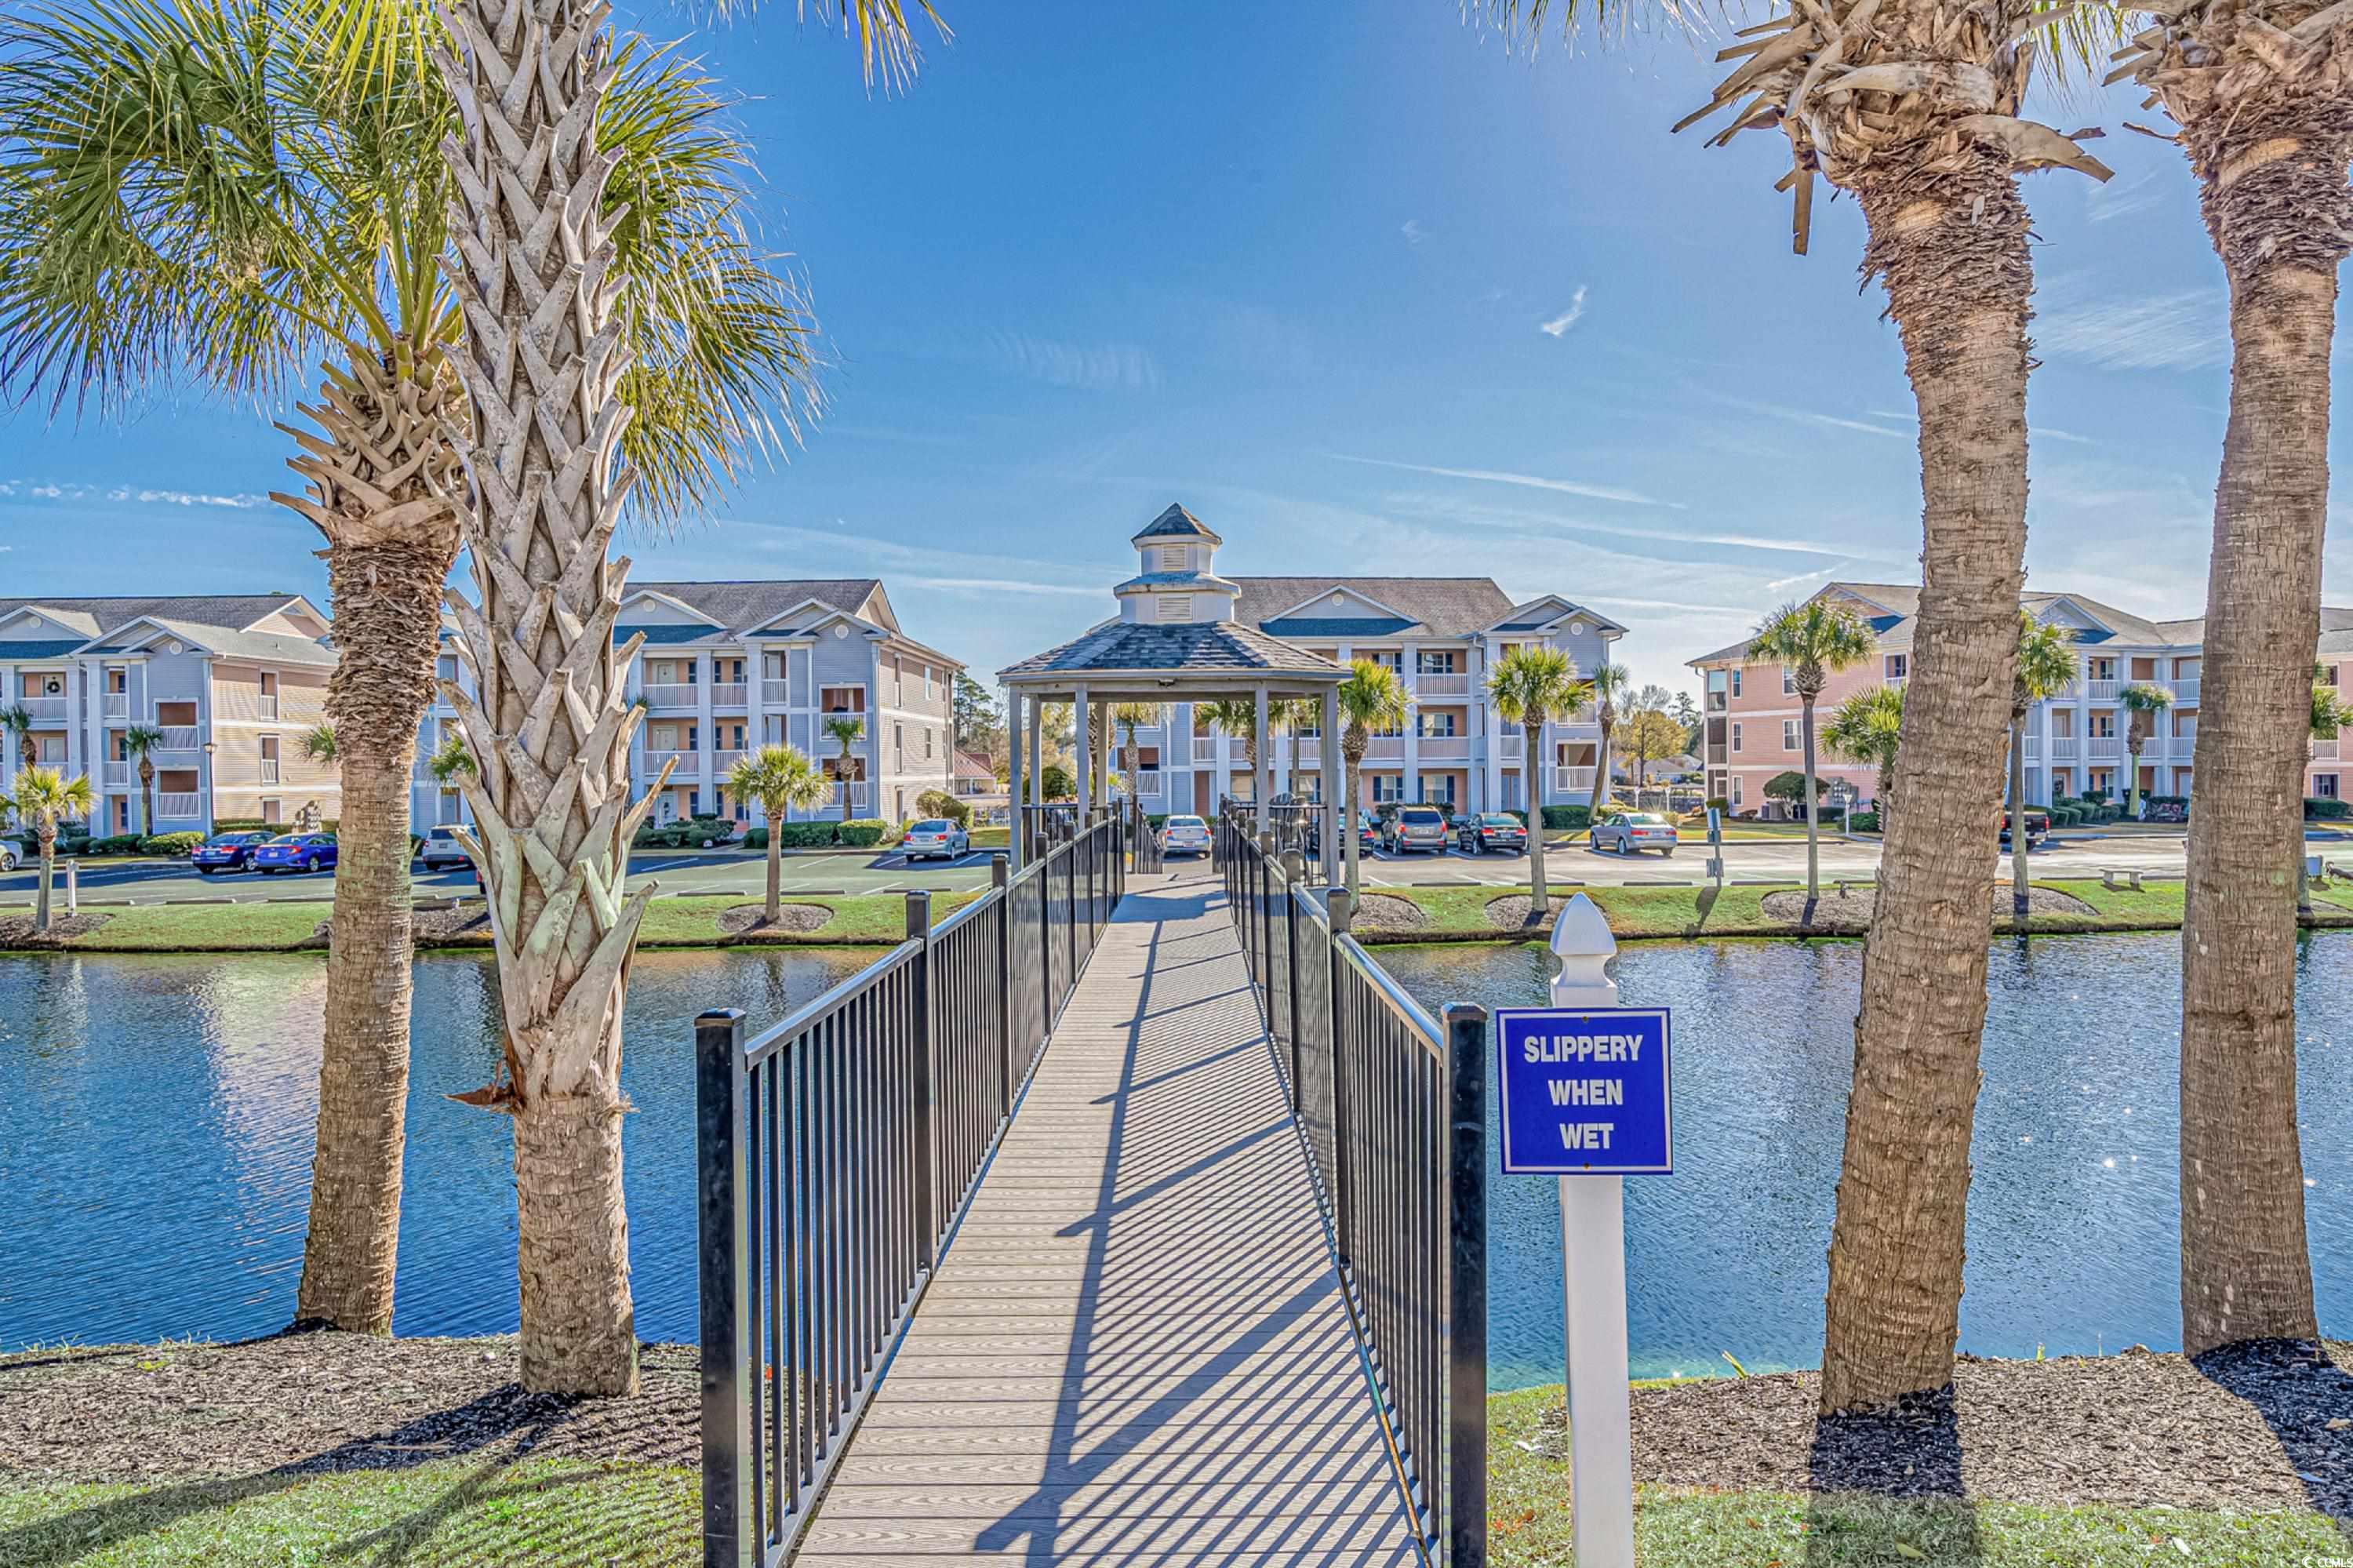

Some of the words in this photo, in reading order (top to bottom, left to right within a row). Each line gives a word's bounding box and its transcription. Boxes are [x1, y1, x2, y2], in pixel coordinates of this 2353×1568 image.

[1523, 1035, 1643, 1063] SLIPPERY
[1547, 1079, 1624, 1106] WHEN
[1559, 1122, 1614, 1150] WET
